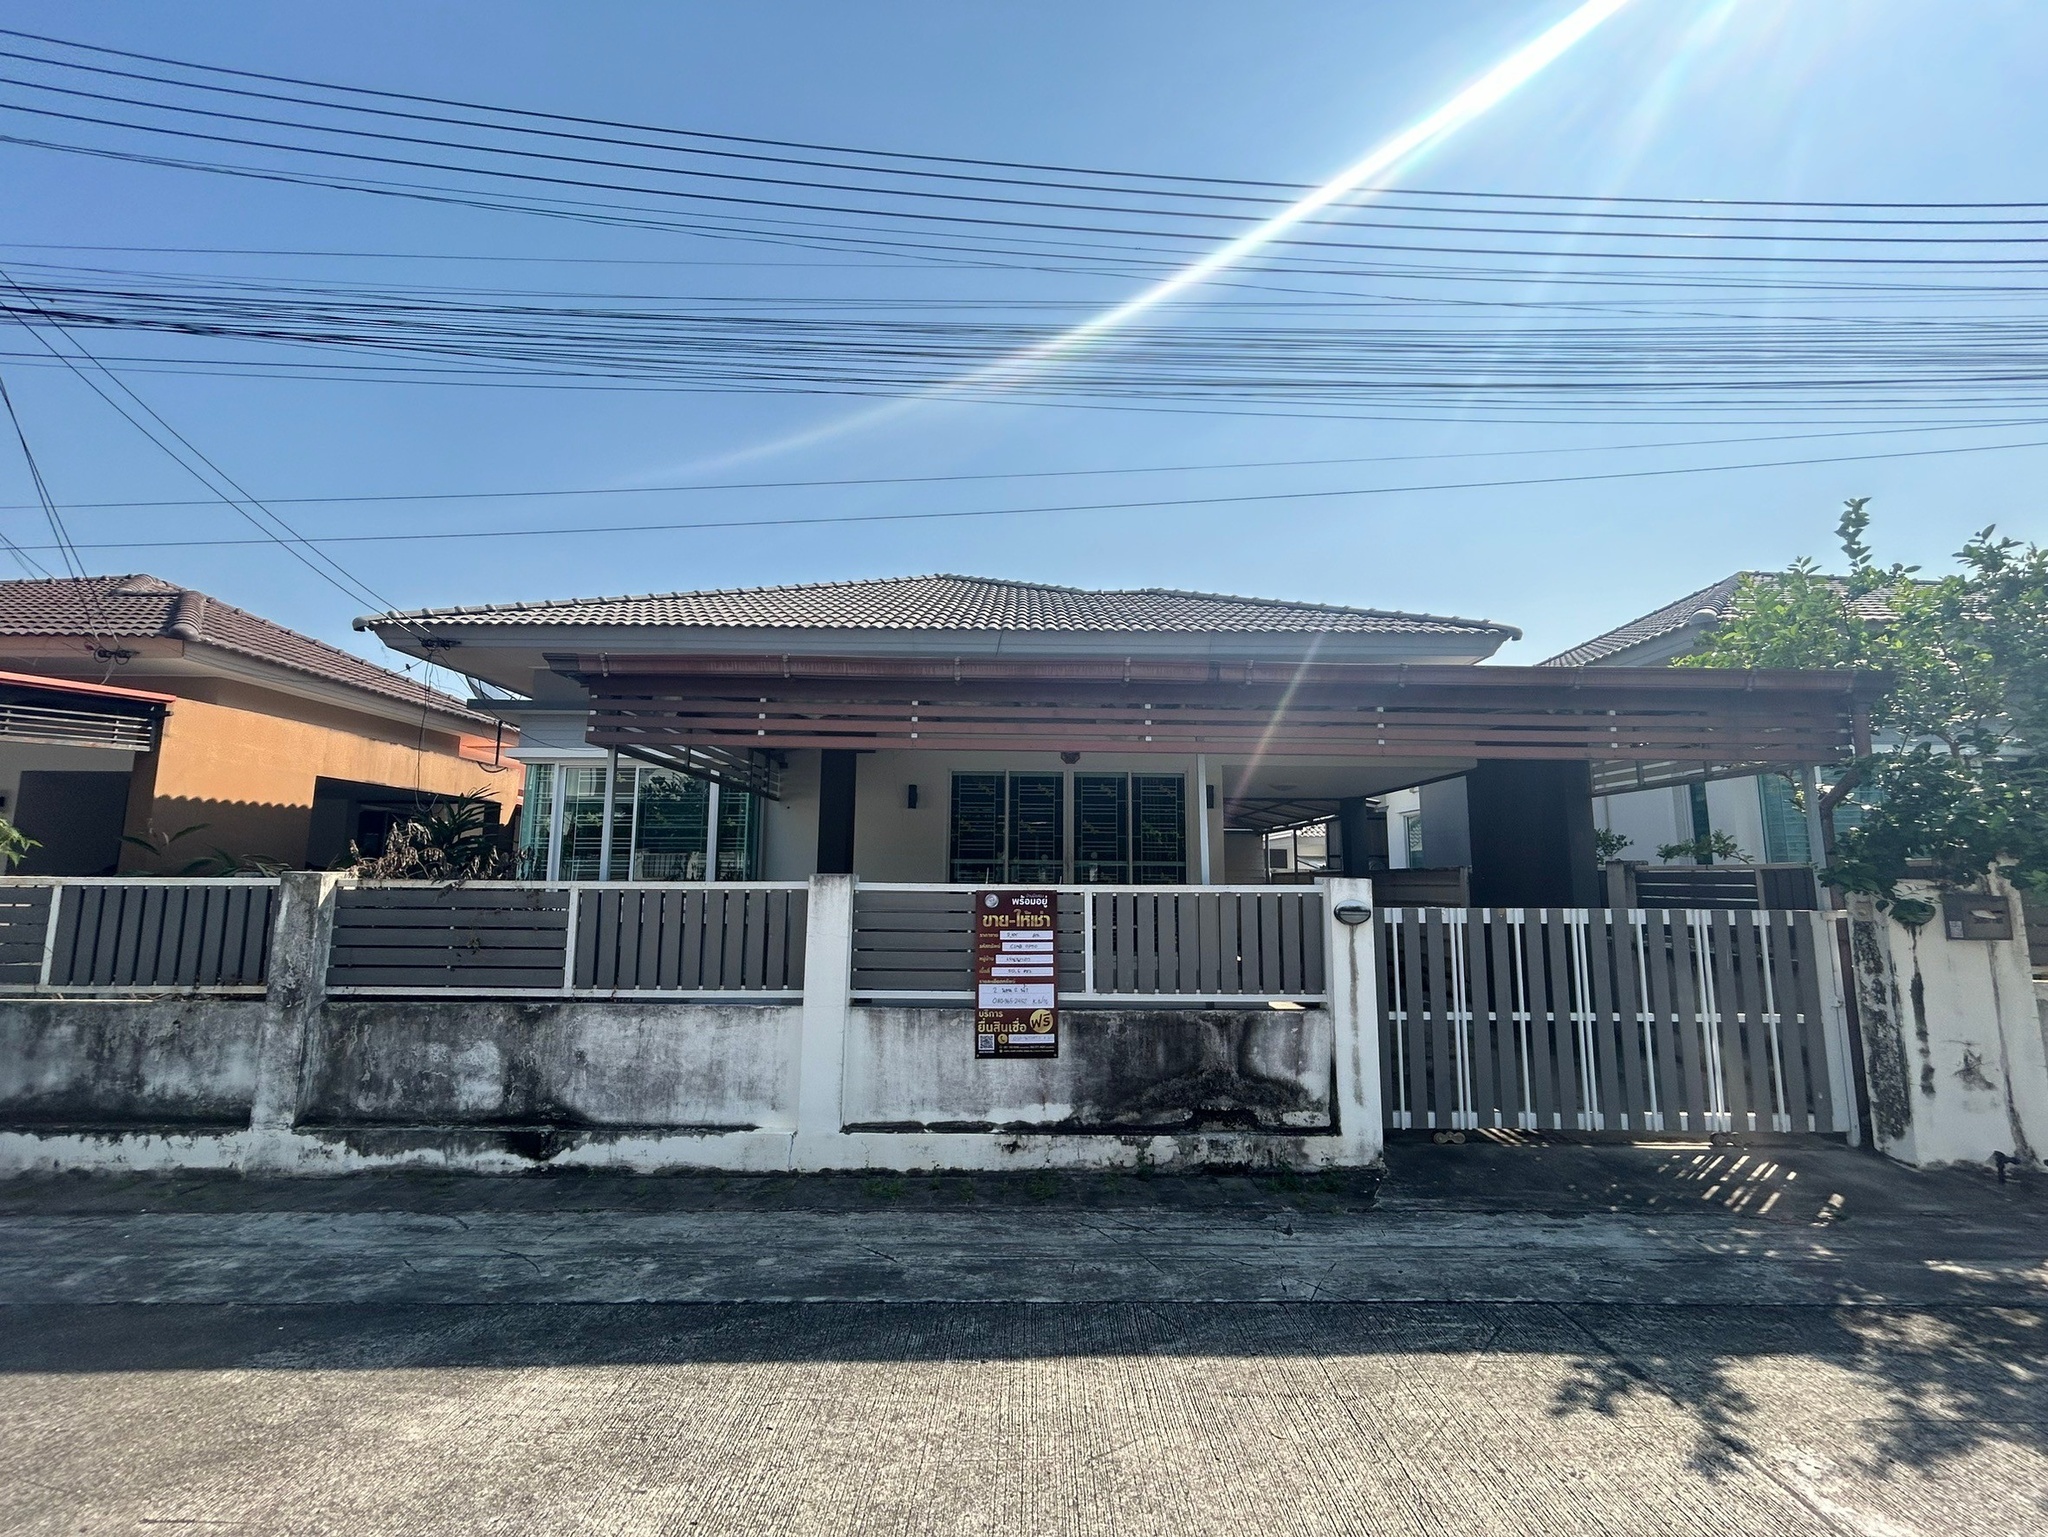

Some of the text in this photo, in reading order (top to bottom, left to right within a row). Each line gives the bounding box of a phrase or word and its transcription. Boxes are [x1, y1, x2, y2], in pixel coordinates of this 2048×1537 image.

[1012, 895, 1048, 908] พร้อมอยู่
[982, 909, 1051, 927] ขาย-ให้เช่า
[978, 1010, 1004, 1018] บริการ
[1031, 1012, 1051, 1028] ฟรี
[977, 1018, 1028, 1033] ยื่นสินเชื่อ
